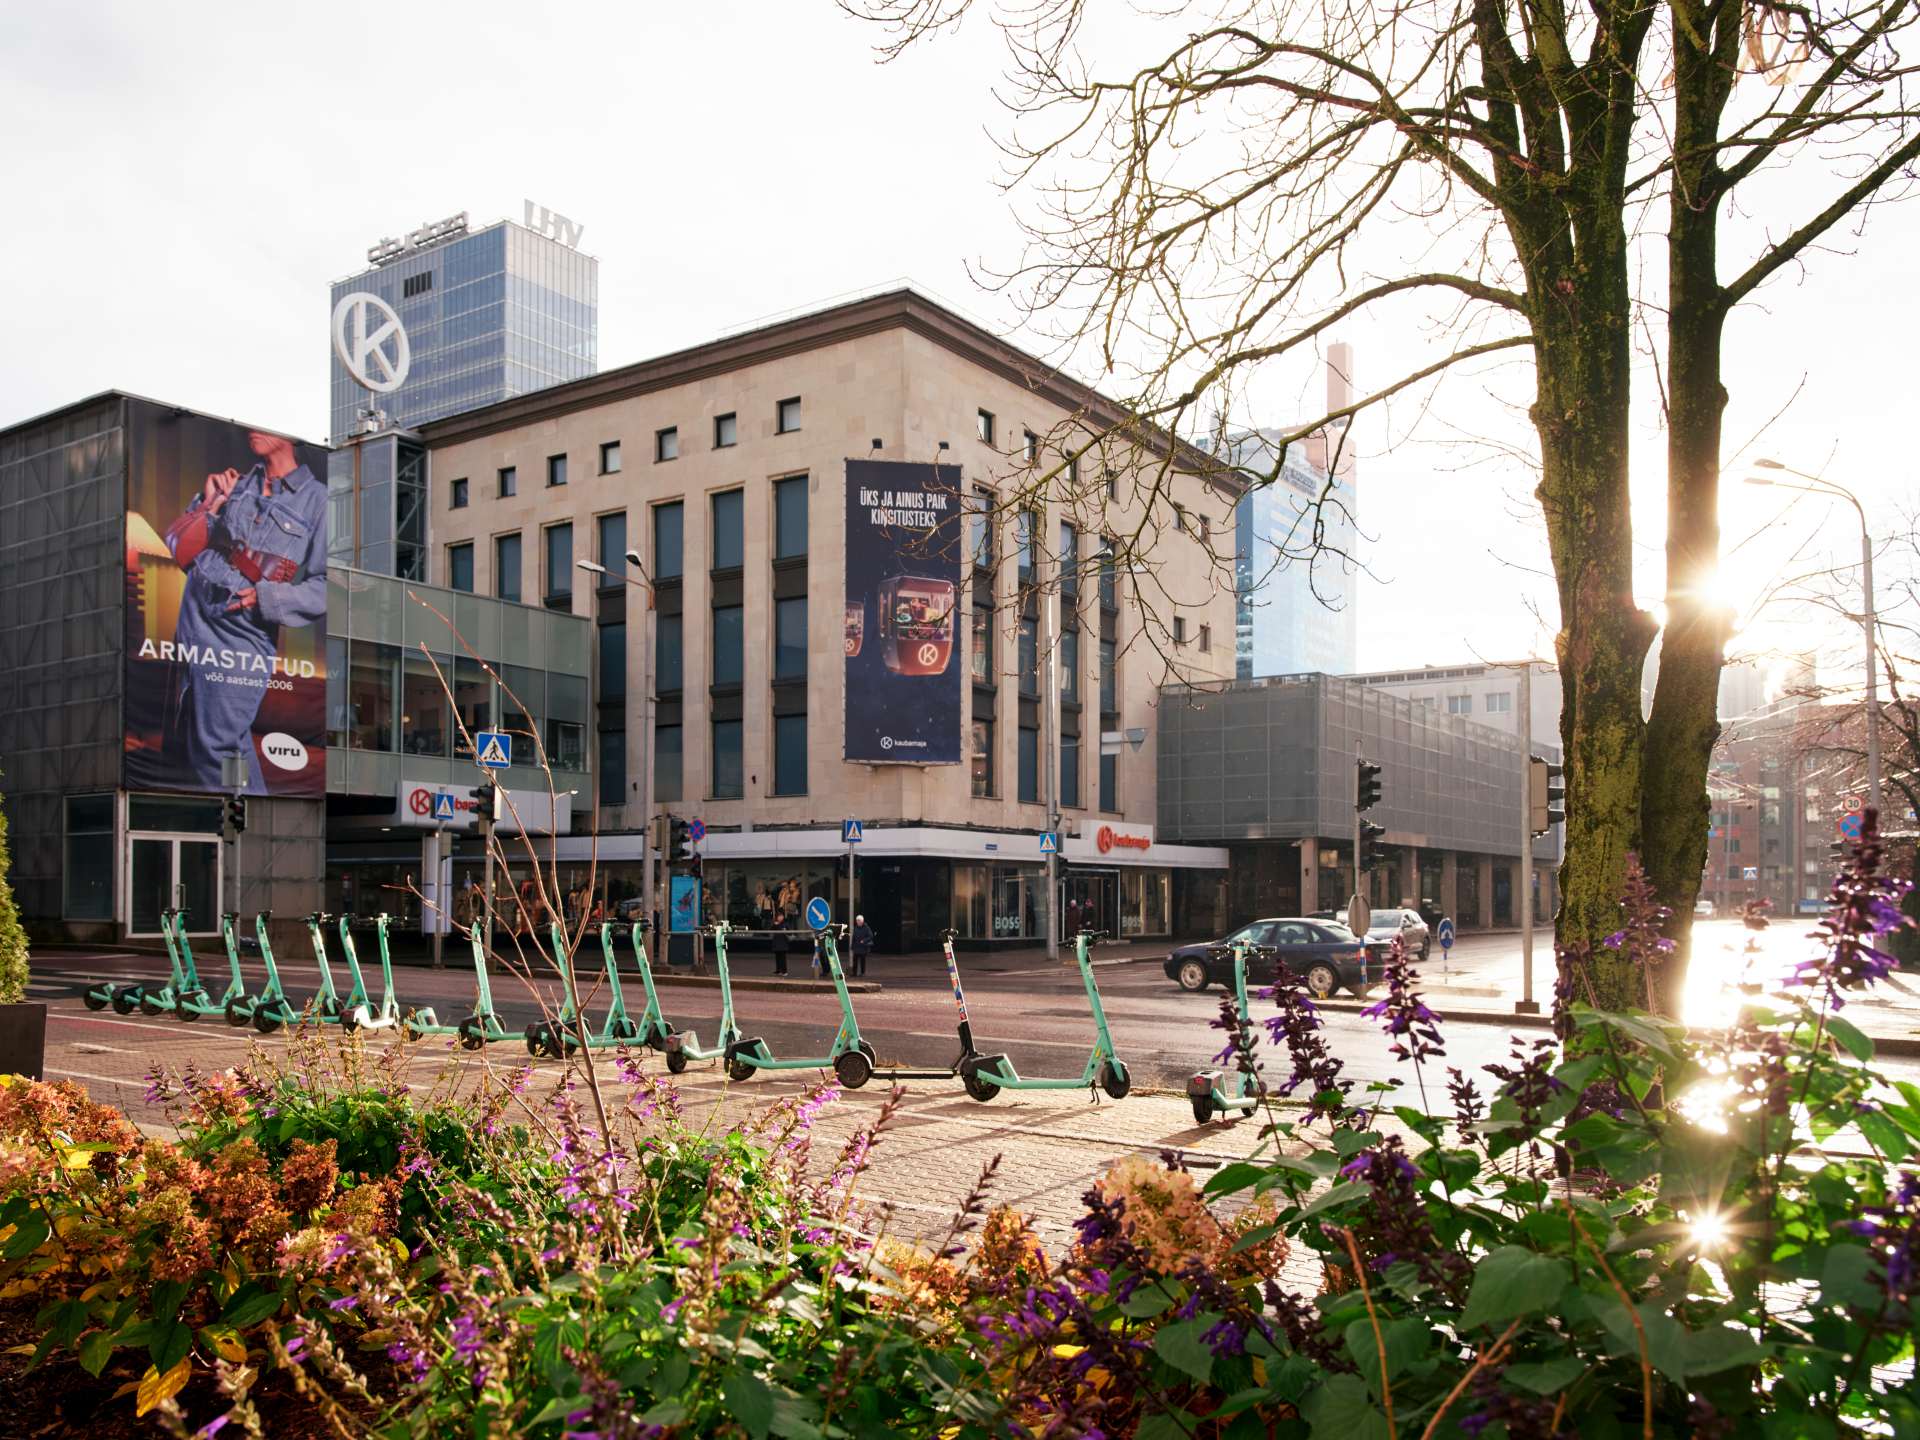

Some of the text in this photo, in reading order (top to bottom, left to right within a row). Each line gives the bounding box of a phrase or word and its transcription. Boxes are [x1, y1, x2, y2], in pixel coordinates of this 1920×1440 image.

[525, 198, 584, 248] LHV
[860, 487, 947, 510] ÜKS JA AINUS PAIK
[871, 508, 936, 527] KINGITUSTEKS
[138, 637, 316, 679] ARMASTATUD
[226, 675, 263, 688] aastast
[266, 678, 294, 691] 2006
[268, 746, 300, 757] viru
[1847, 799, 1860, 809] 30
[994, 916, 1021, 930] BOSS
